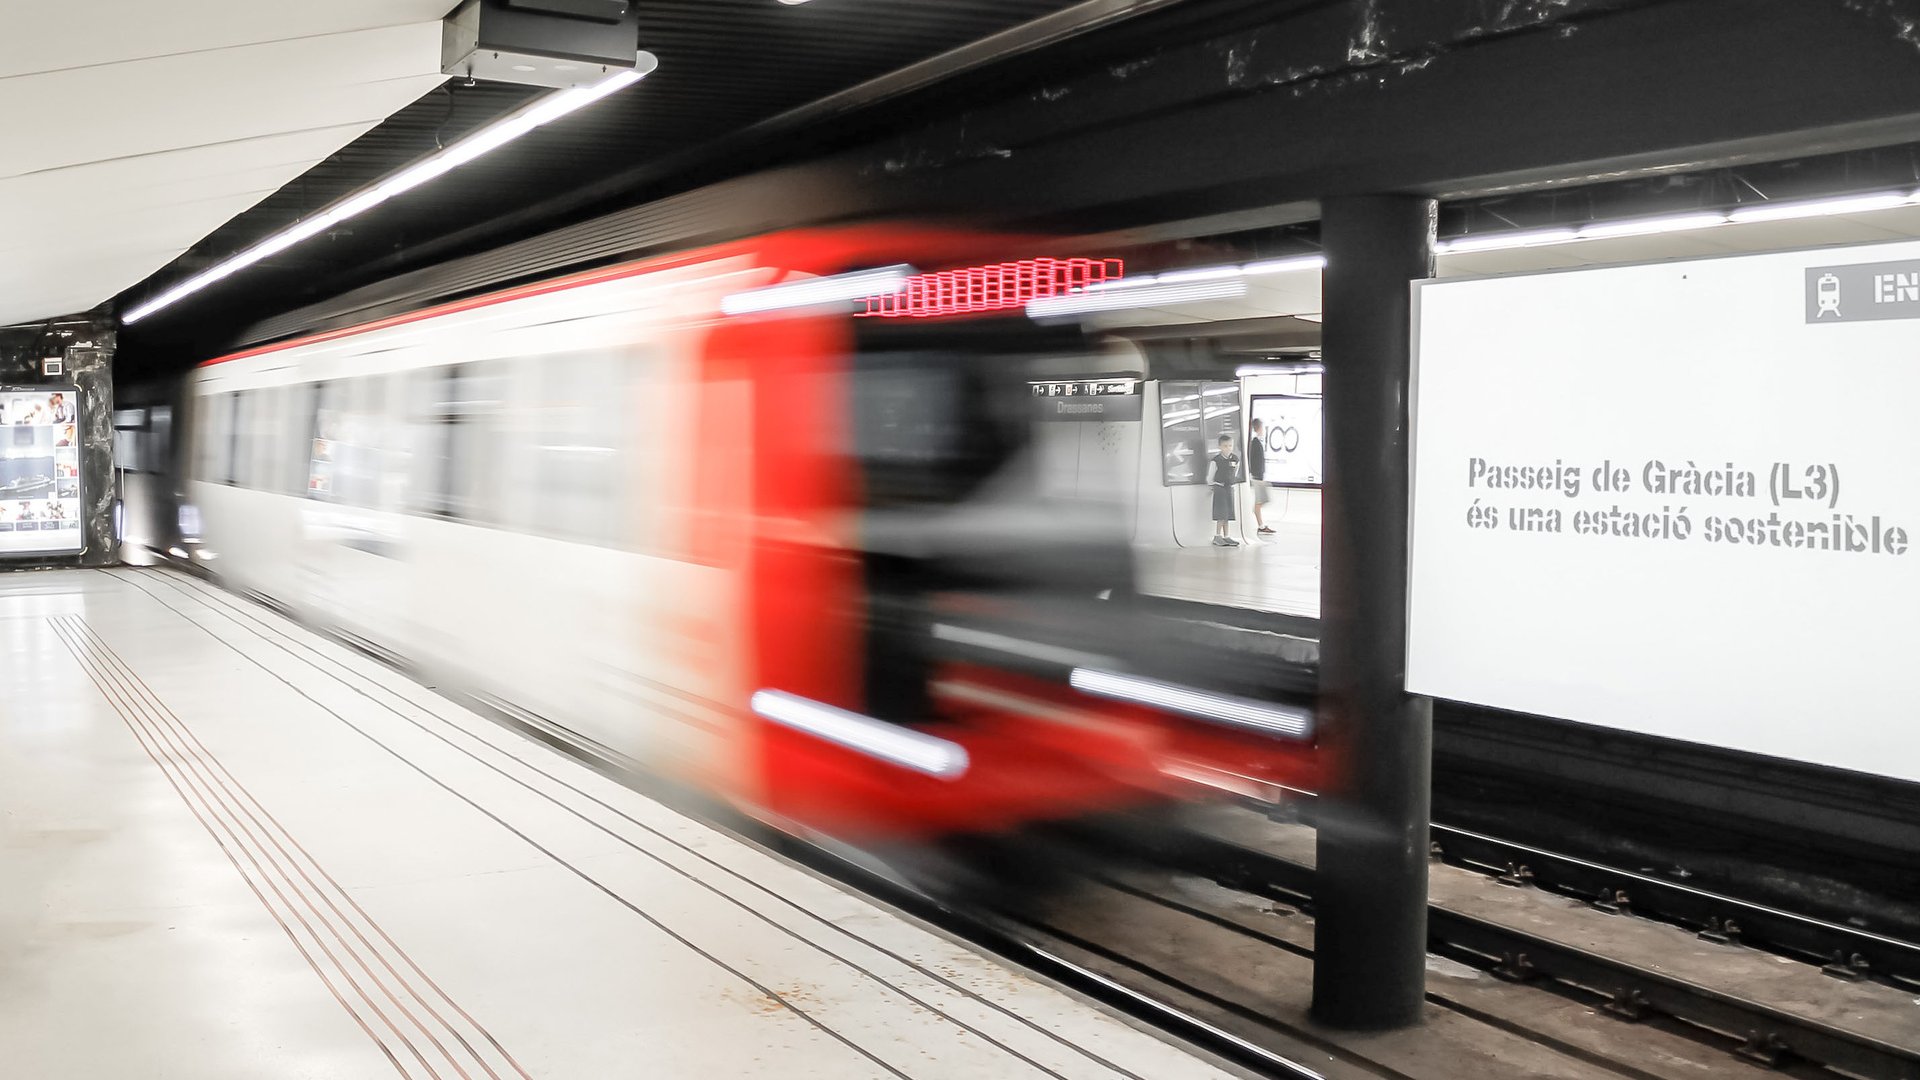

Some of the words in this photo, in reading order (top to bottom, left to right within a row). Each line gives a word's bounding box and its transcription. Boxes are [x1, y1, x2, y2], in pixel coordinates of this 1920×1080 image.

[1468, 457, 1581, 498] Passeig
[1592, 459, 1631, 493] de
[1642, 460, 1756, 498] Gràcia
[1769, 462, 1840, 509] (L3)
[1466, 498, 1499, 529] és
[1509, 506, 1562, 533] una
[1573, 504, 1692, 540] estació
[1704, 513, 1908, 556] sostenible
